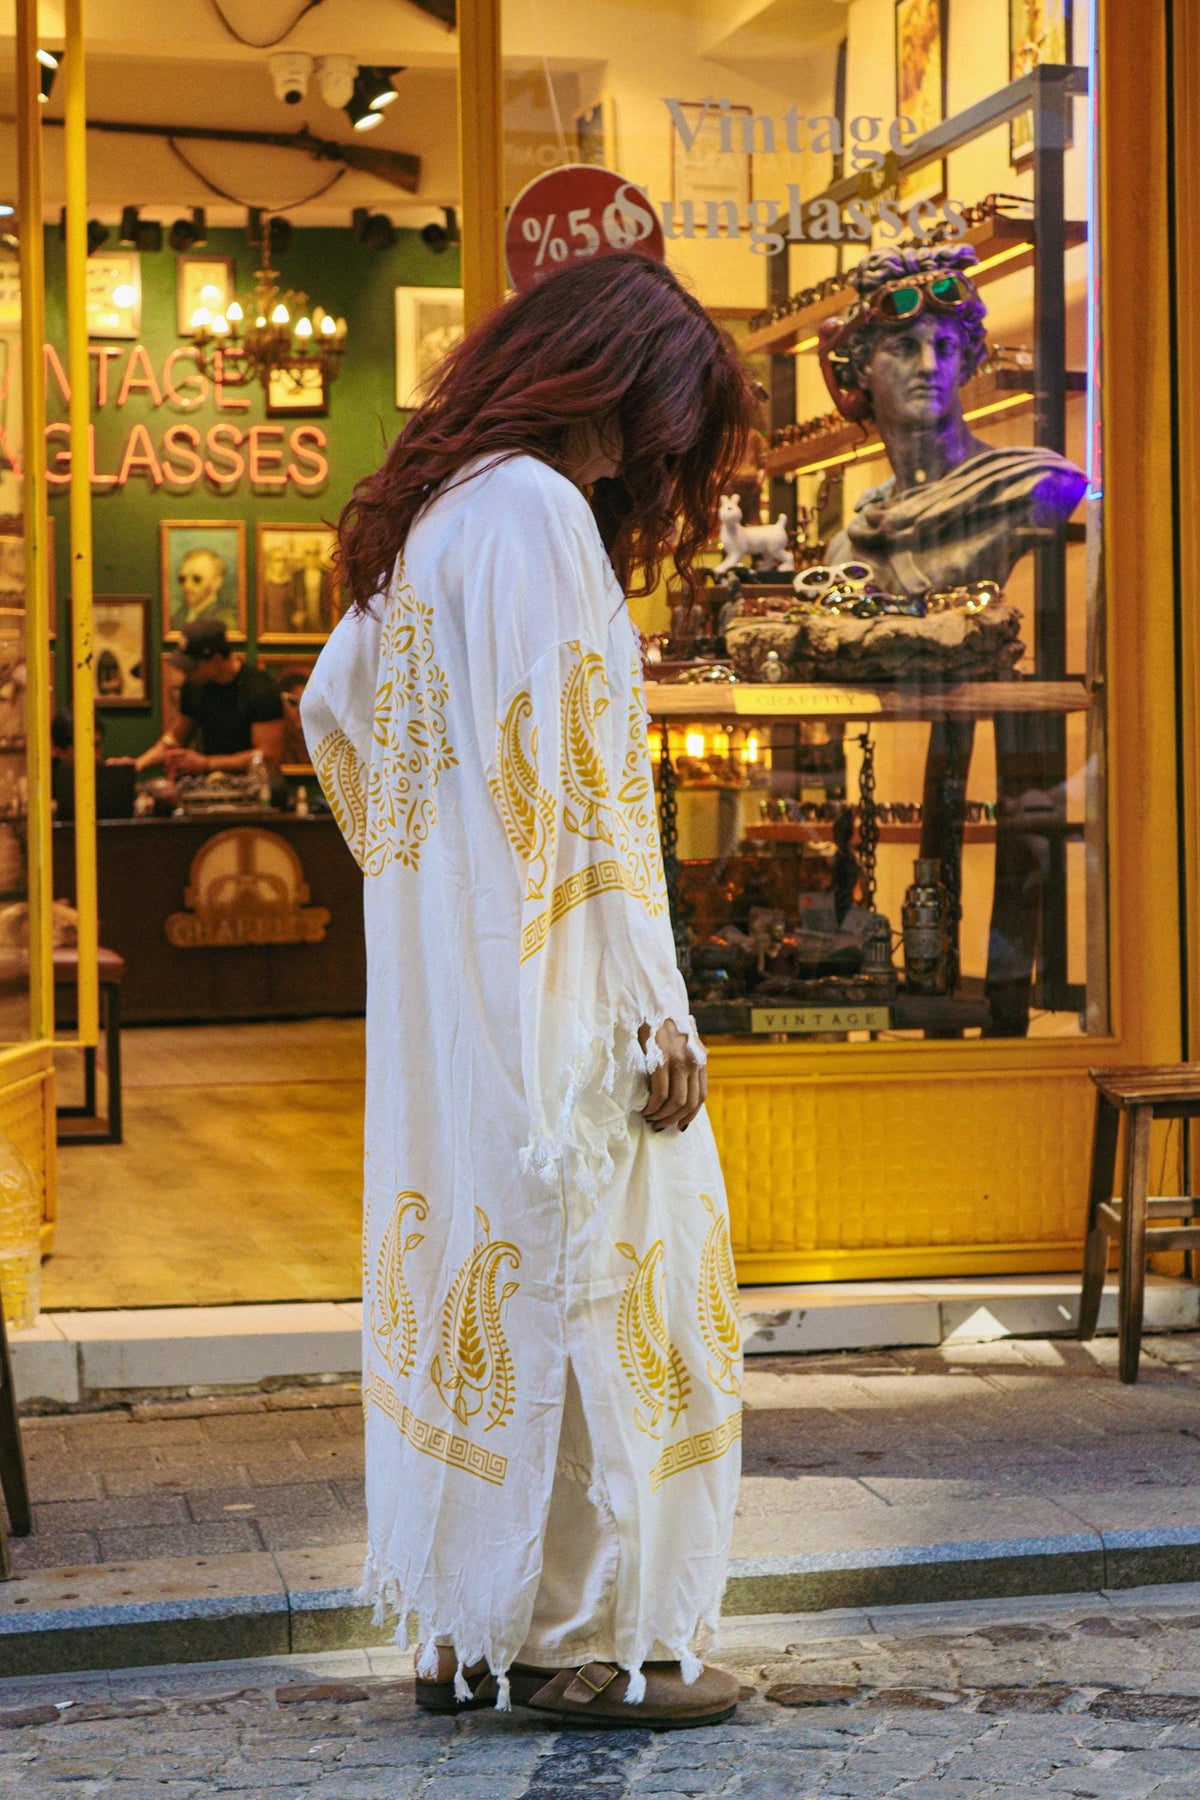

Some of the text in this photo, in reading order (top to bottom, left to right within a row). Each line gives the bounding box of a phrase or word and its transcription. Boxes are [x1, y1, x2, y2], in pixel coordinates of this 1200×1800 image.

[661, 97, 919, 172] Vintage
[614, 181, 967, 256] Sunglasses
[763, 1012, 877, 1026] VINTAGE
